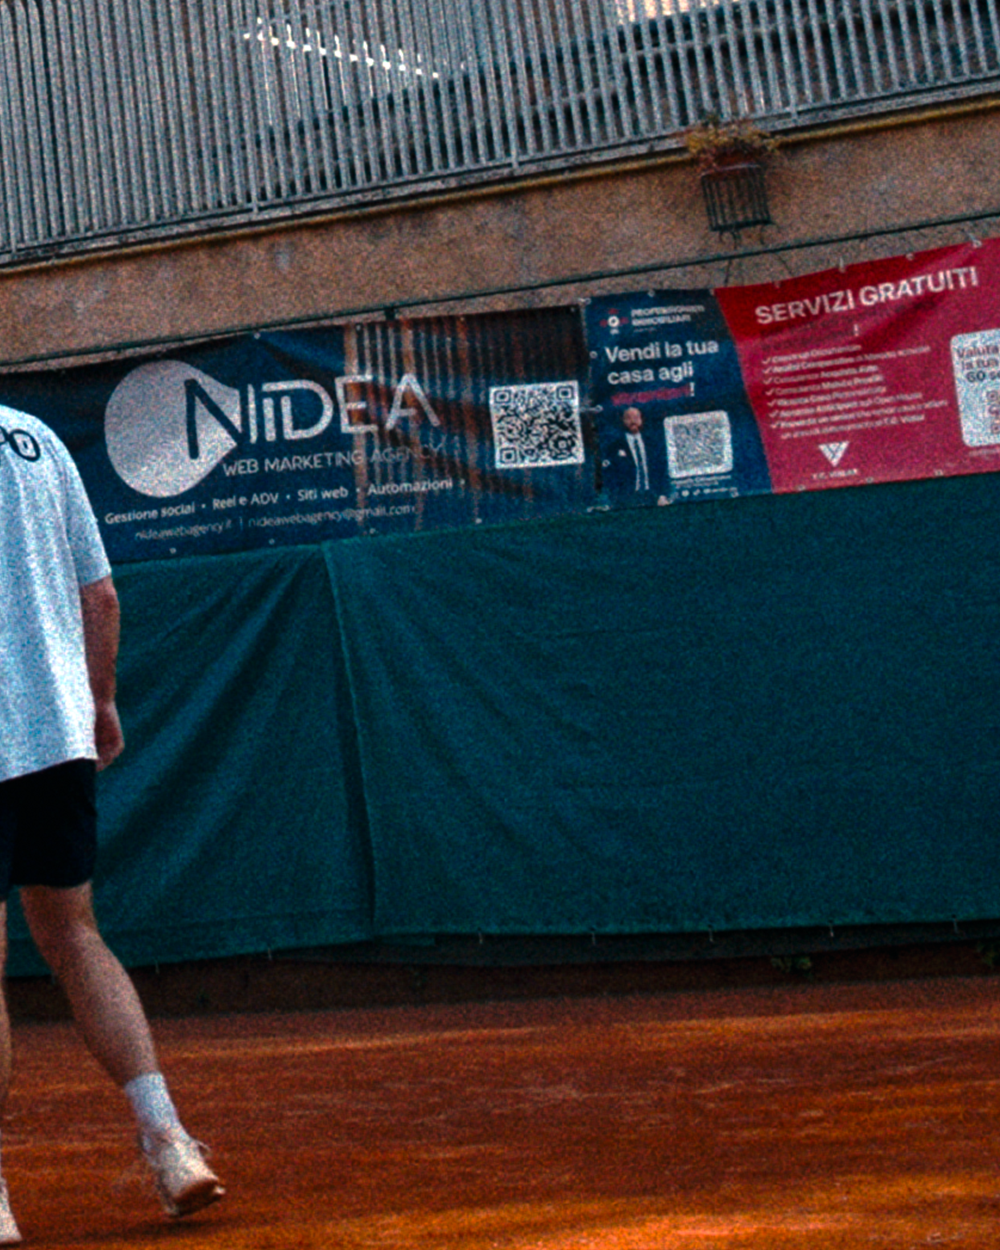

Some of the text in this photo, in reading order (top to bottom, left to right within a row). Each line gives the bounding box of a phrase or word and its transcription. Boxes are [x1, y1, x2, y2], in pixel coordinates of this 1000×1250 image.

[755, 265, 980, 326] SERVIZI GRATUITI
[605, 338, 720, 364] Vendi la tua
[607, 361, 695, 386] casa agli
[222, 440, 448, 478] WEB MARKETING AGENCY
[104, 477, 453, 526] Gestione social Reel e ADV Siti web Automazioni
